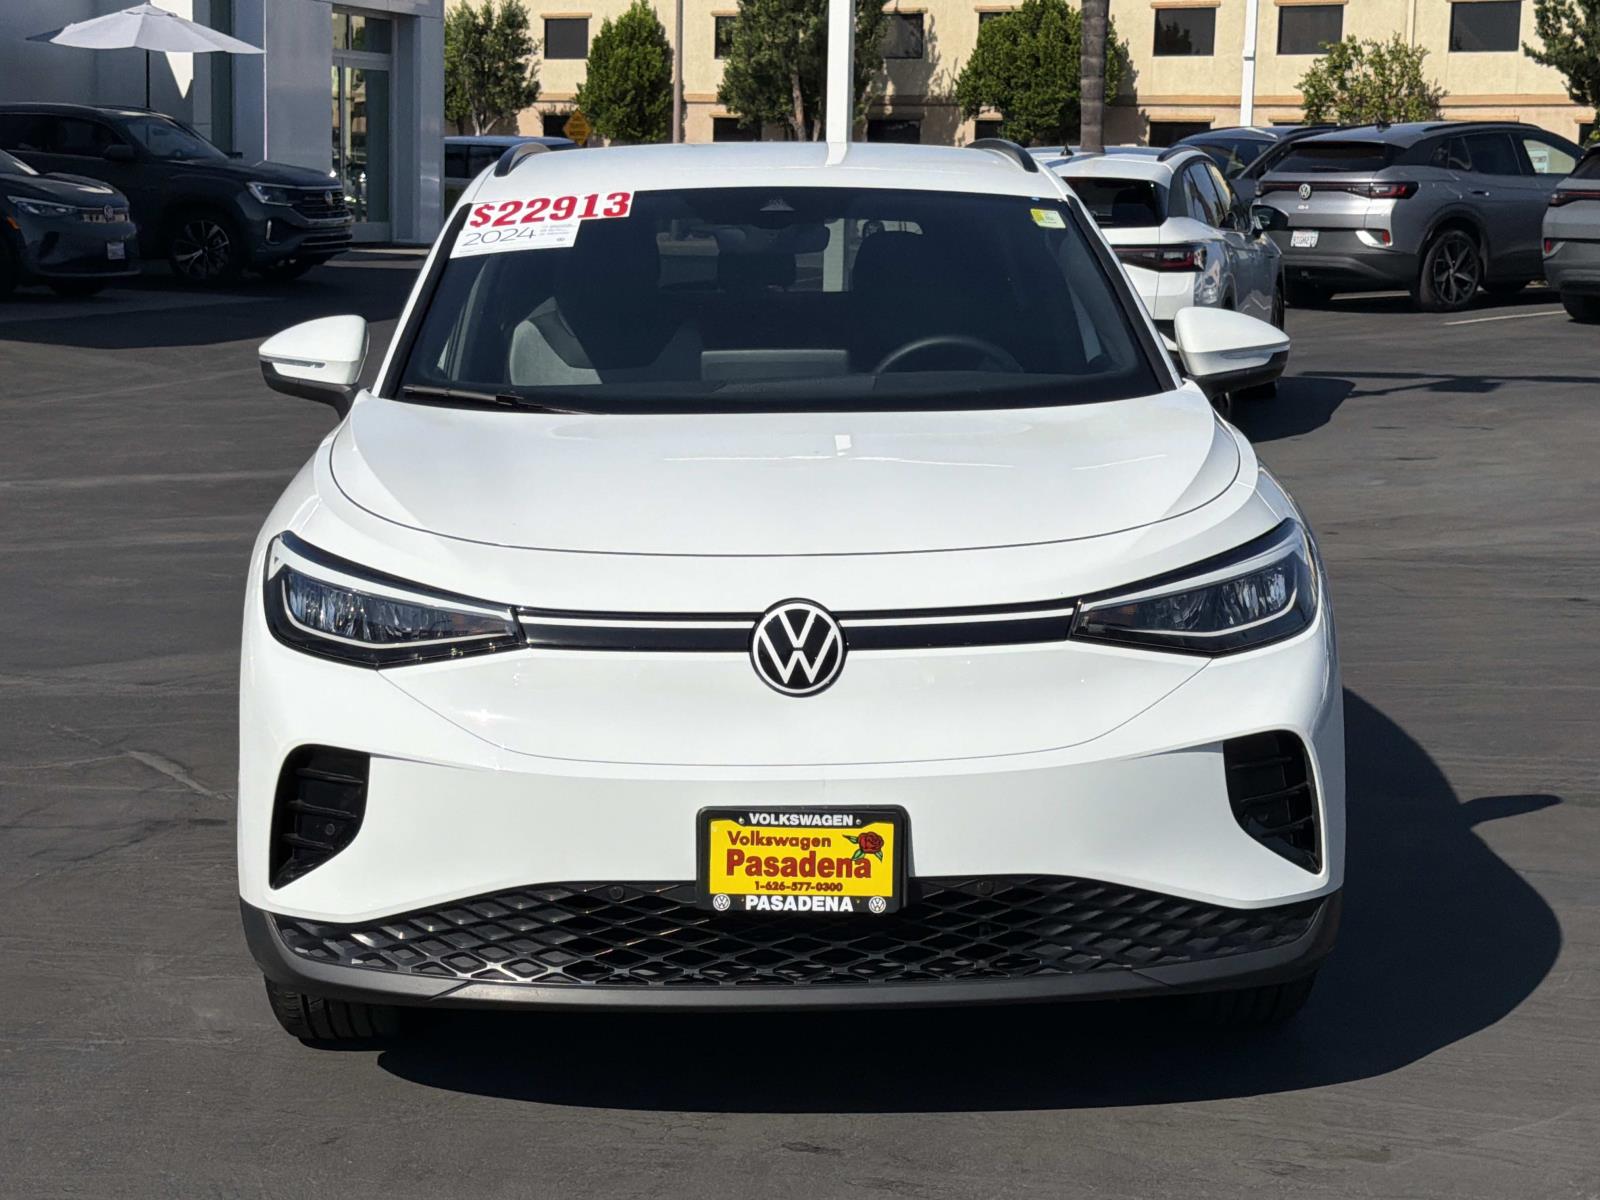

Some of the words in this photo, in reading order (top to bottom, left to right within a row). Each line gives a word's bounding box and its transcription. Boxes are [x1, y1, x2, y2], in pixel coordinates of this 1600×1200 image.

[469, 191, 631, 228] $22913
[462, 226, 536, 247] 2024
[756, 606, 840, 688] VW
[749, 812, 854, 827] VOLKSWAGEN
[727, 830, 832, 850] Volkswagen
[726, 848, 872, 879] Pasadena
[755, 880, 843, 892] 1-626-577-0300
[745, 895, 854, 912] PASADENA
